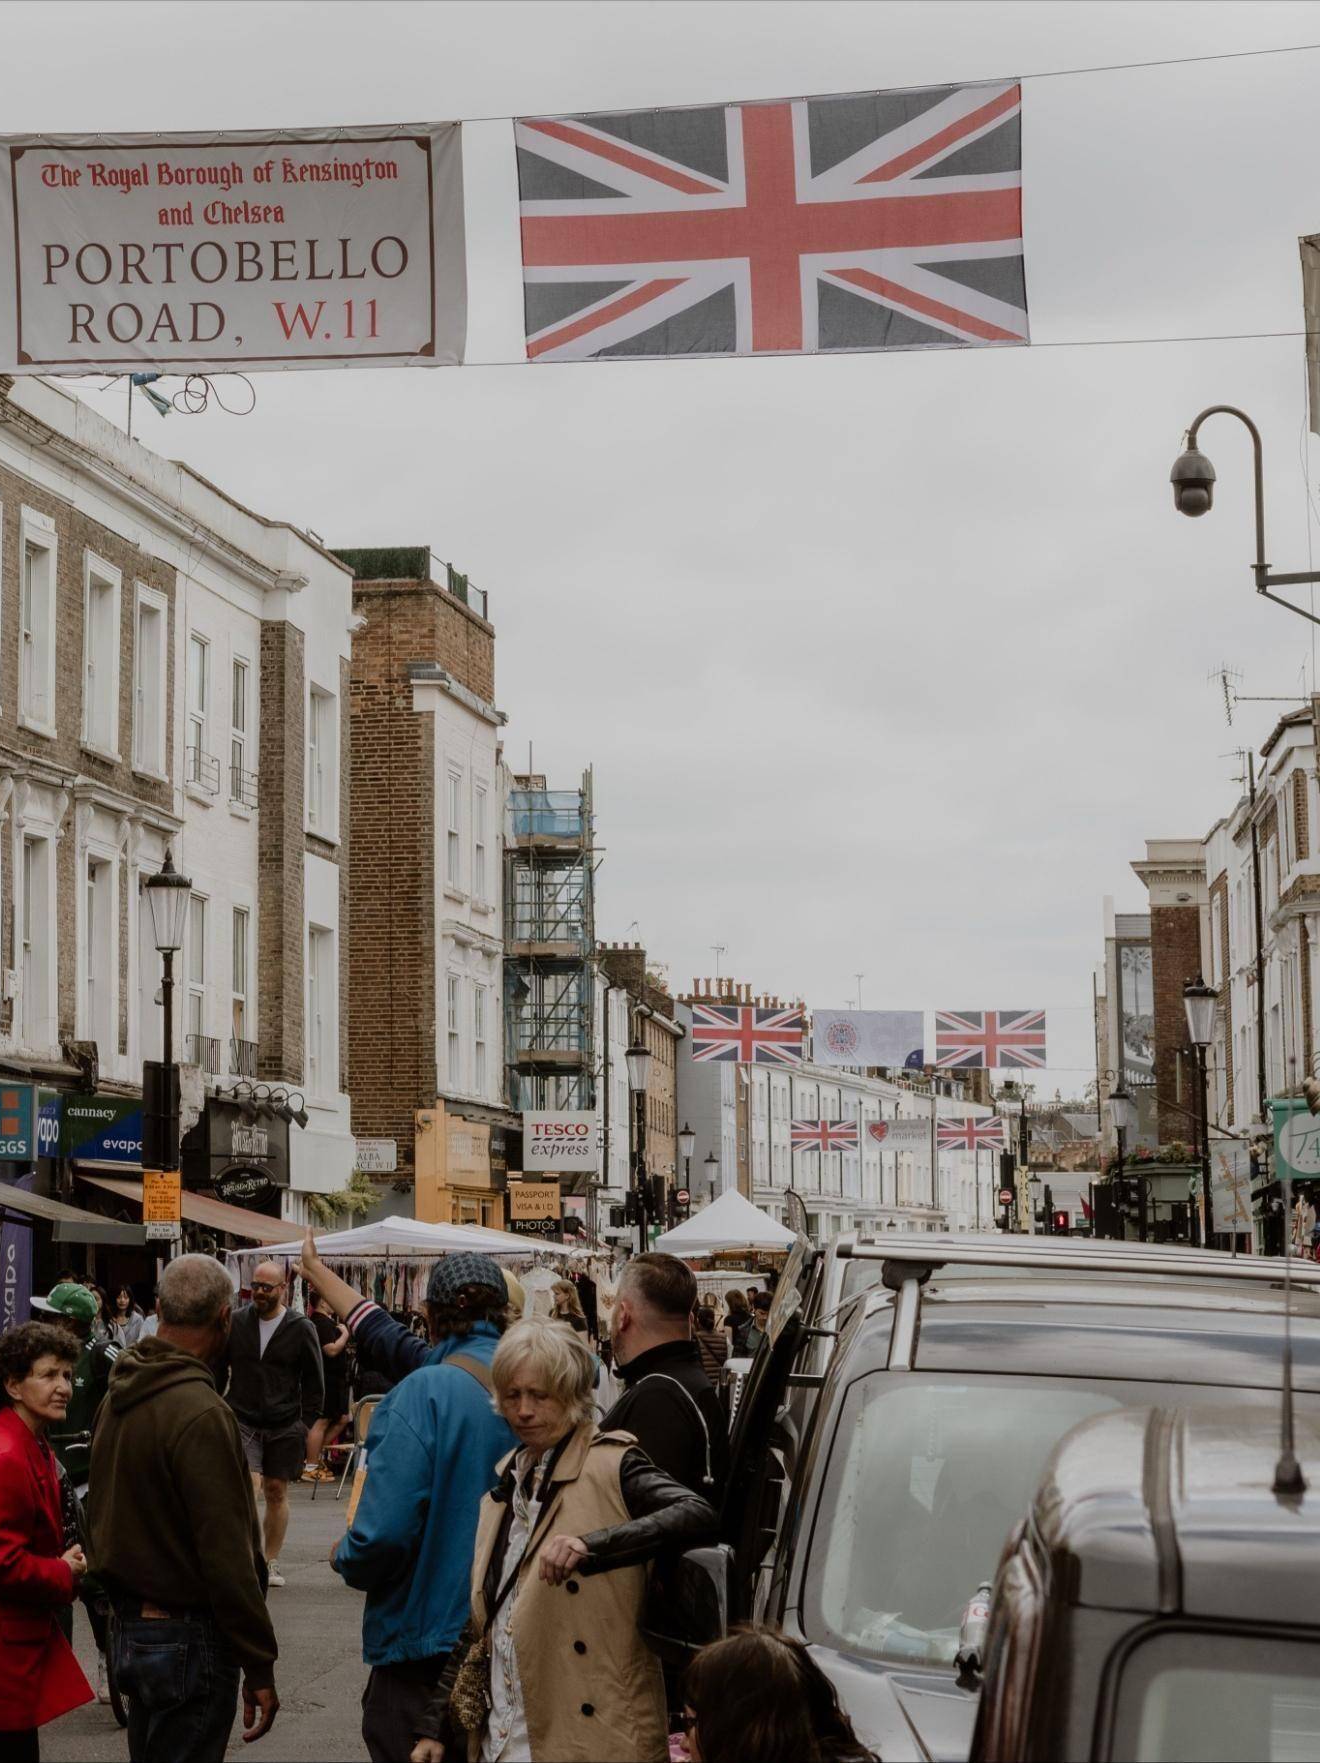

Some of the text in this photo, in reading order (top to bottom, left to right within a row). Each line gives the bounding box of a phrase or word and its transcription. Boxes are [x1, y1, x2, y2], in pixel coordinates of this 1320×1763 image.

[41, 157, 399, 194] The Royal Borough of Kensington
[157, 200, 285, 226] and Chelsea
[42, 235, 409, 285] PORTOBELLO
[67, 298, 381, 347] ROAD, W.11
[67, 1107, 117, 1121] cannacy
[37, 1117, 60, 1152] vapo
[531, 1123, 589, 1136] TESCO
[531, 1143, 590, 1159] express
[355, 1161, 373, 1169] ACE
[515, 1190, 555, 1199] PASSPORT
[516, 1202, 533, 1210] VISA
[535, 1202, 541, 1211] &
[516, 1220, 556, 1230] PHOTOS
